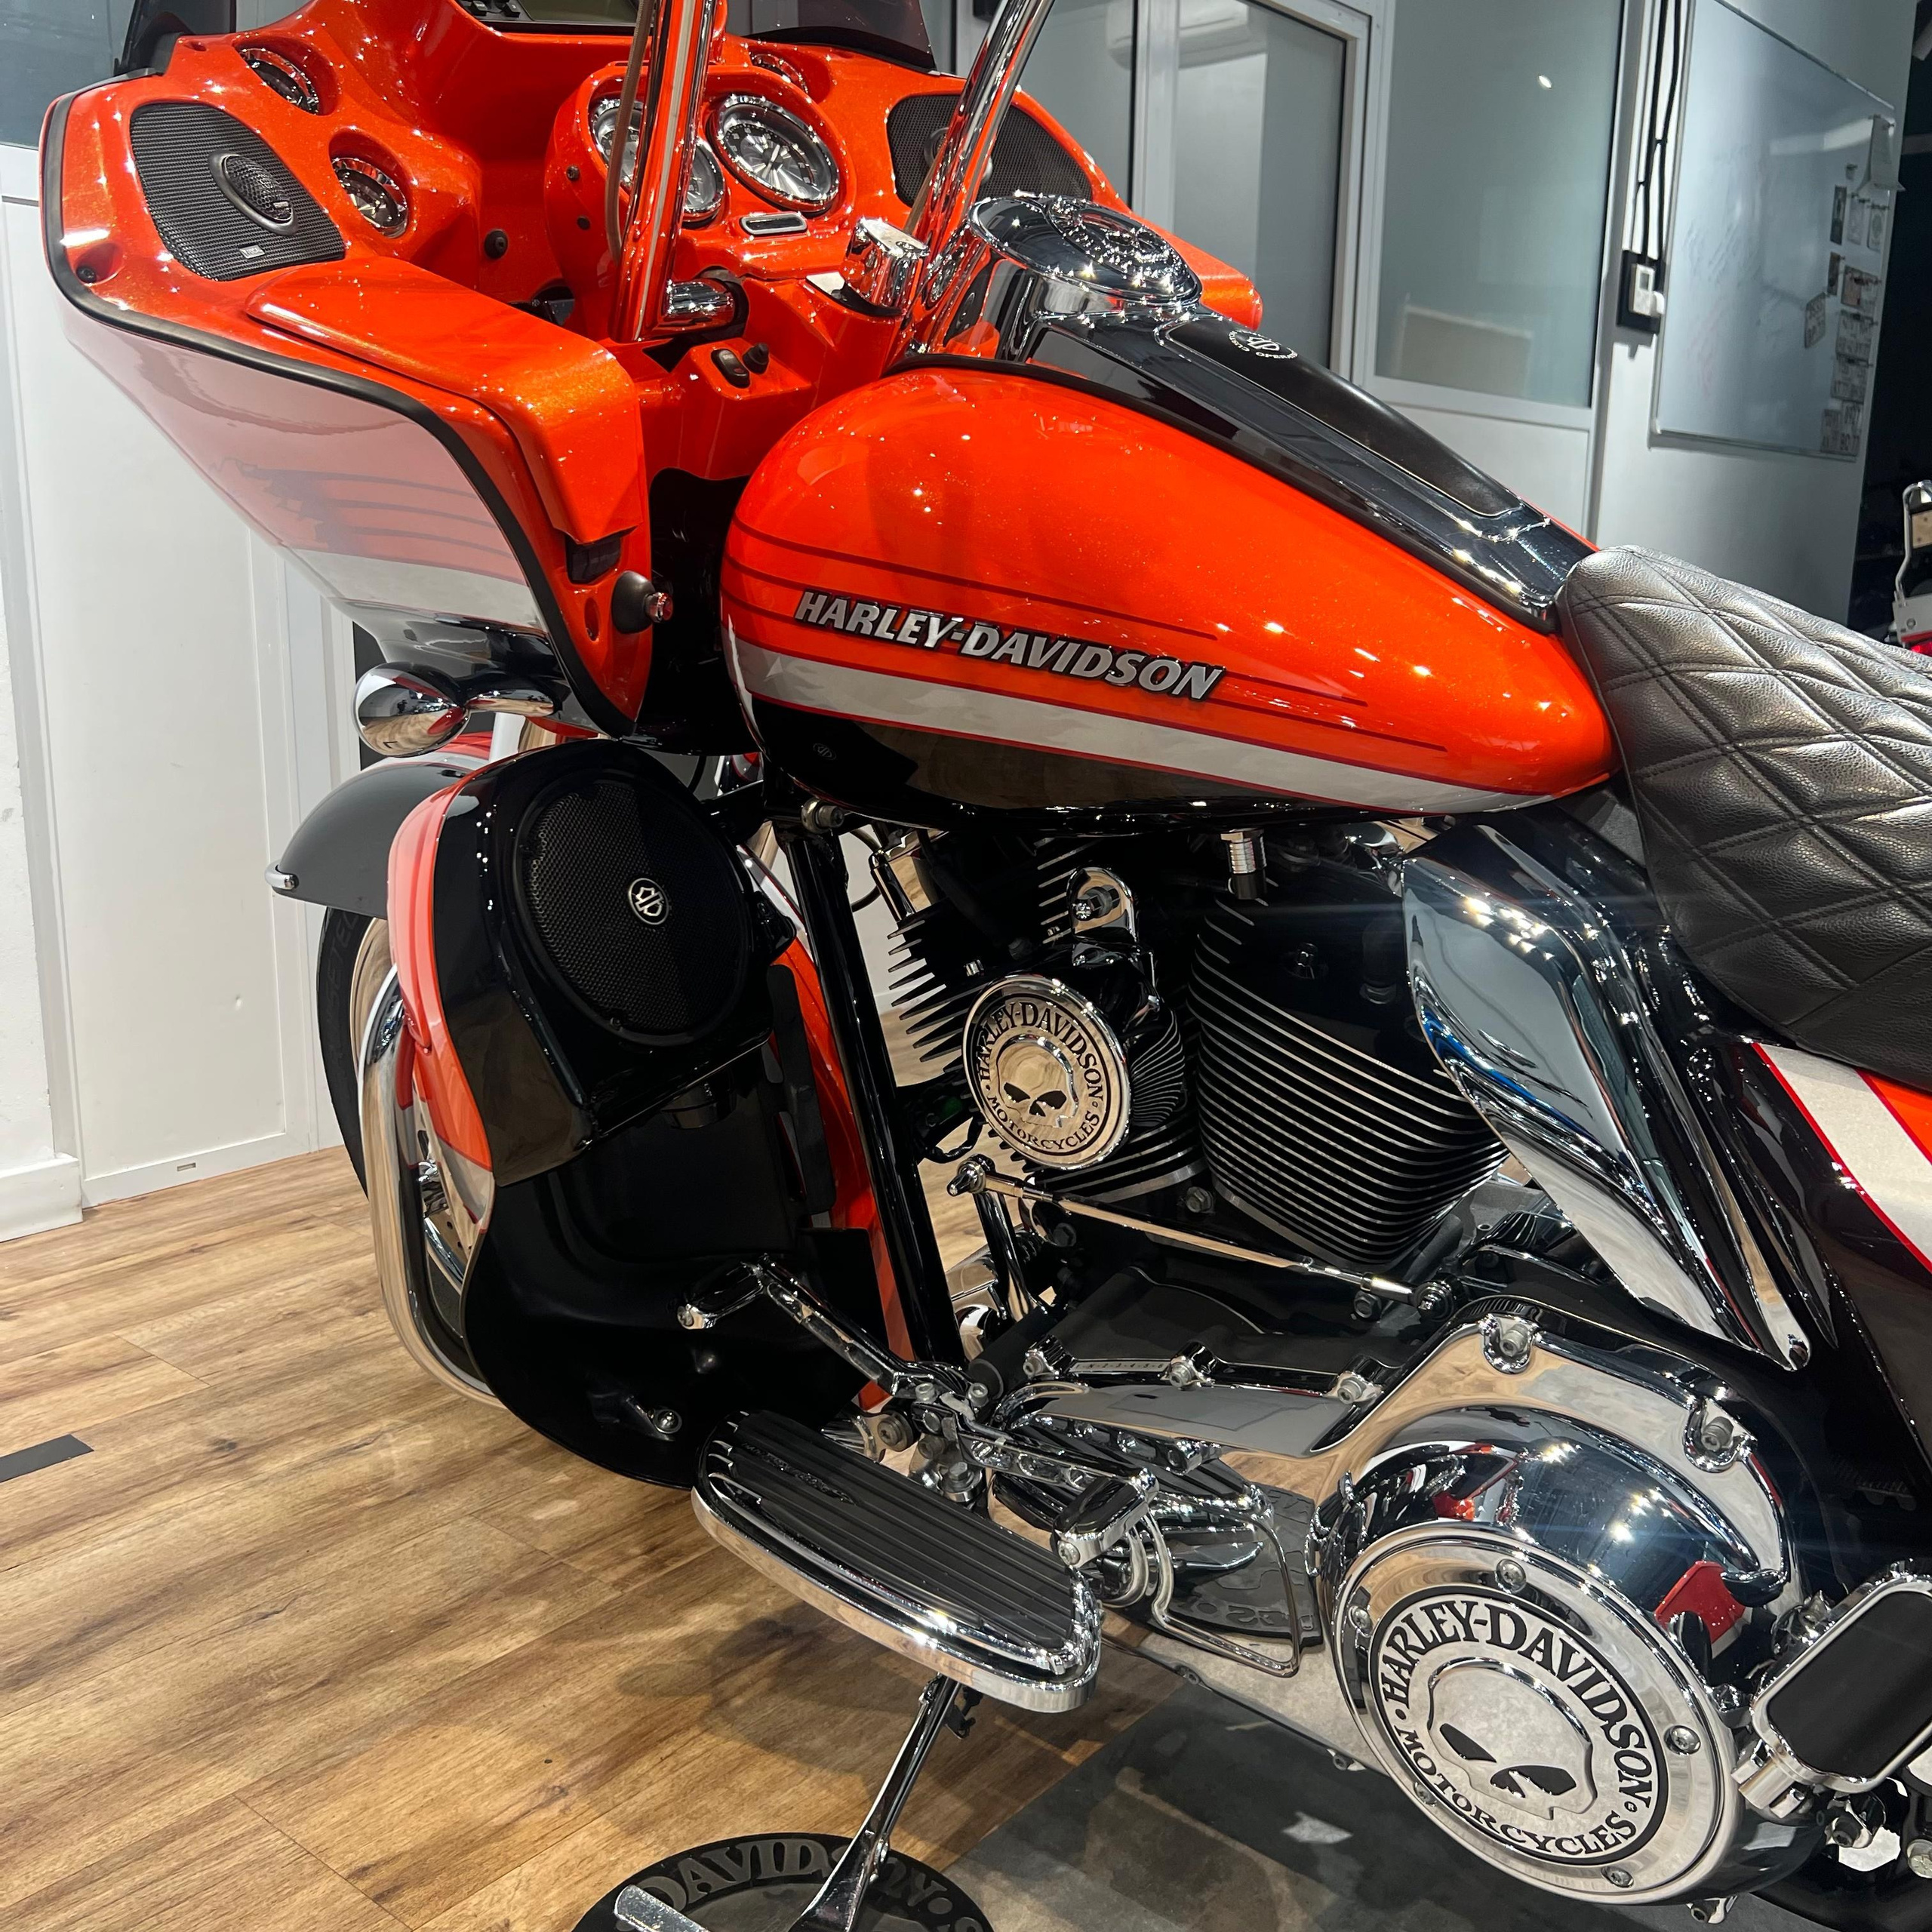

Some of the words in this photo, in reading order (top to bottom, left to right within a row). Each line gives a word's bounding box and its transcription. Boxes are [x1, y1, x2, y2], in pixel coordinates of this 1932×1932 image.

[793, 589, 1226, 701] HARLEY-DAVIDSON
[977, 1001, 1103, 1101] HARLEY-DAVIDSON
[986, 1095, 1100, 1150] MOTORCYCLES
[1380, 1600, 1654, 1807] HARLEY-DAVIDSON
[1395, 1726, 1637, 1856] MOTORCYCLES
